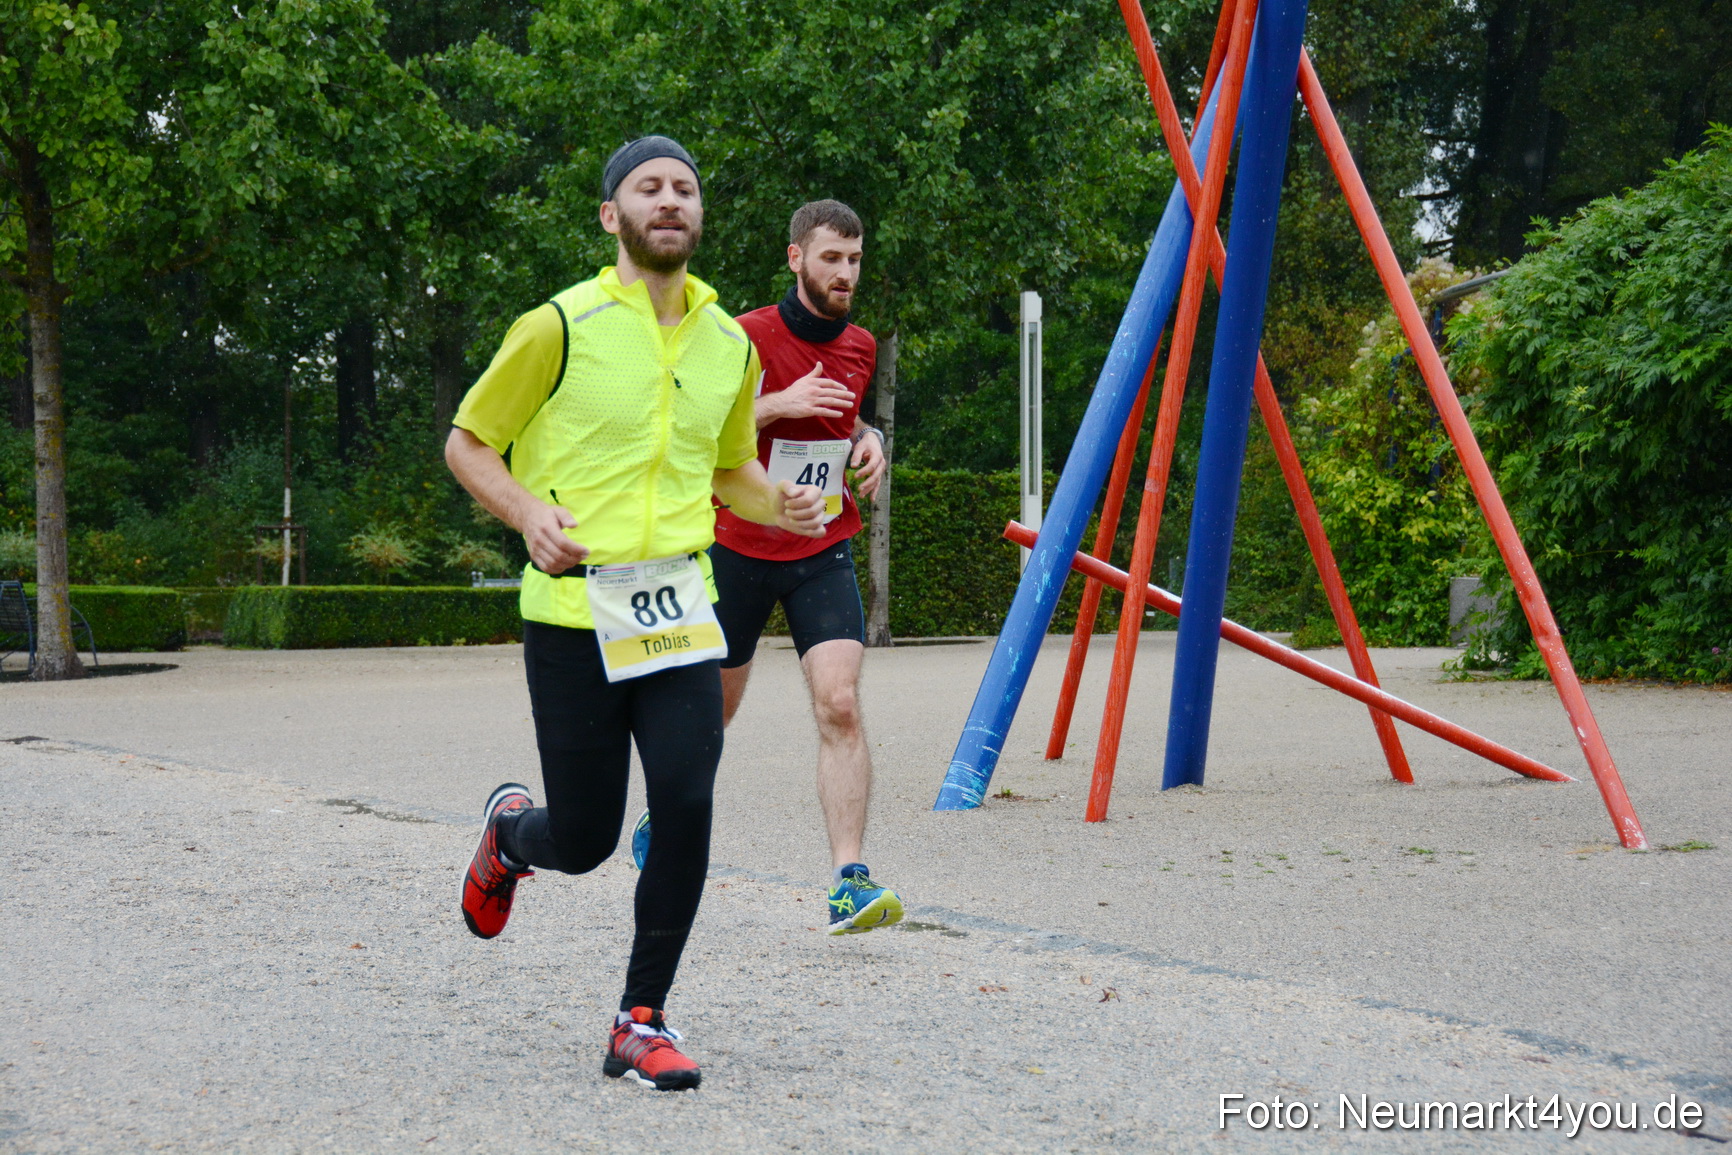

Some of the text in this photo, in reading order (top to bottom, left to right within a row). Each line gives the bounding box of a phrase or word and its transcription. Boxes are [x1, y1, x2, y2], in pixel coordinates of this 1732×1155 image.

[812, 444, 846, 454] BOCK
[796, 462, 829, 491] 48
[644, 558, 688, 578] BOCK
[597, 576, 638, 585] NeuerMarkt
[631, 585, 684, 627] 80
[604, 633, 610, 641] A
[641, 632, 691, 656] Tobias
